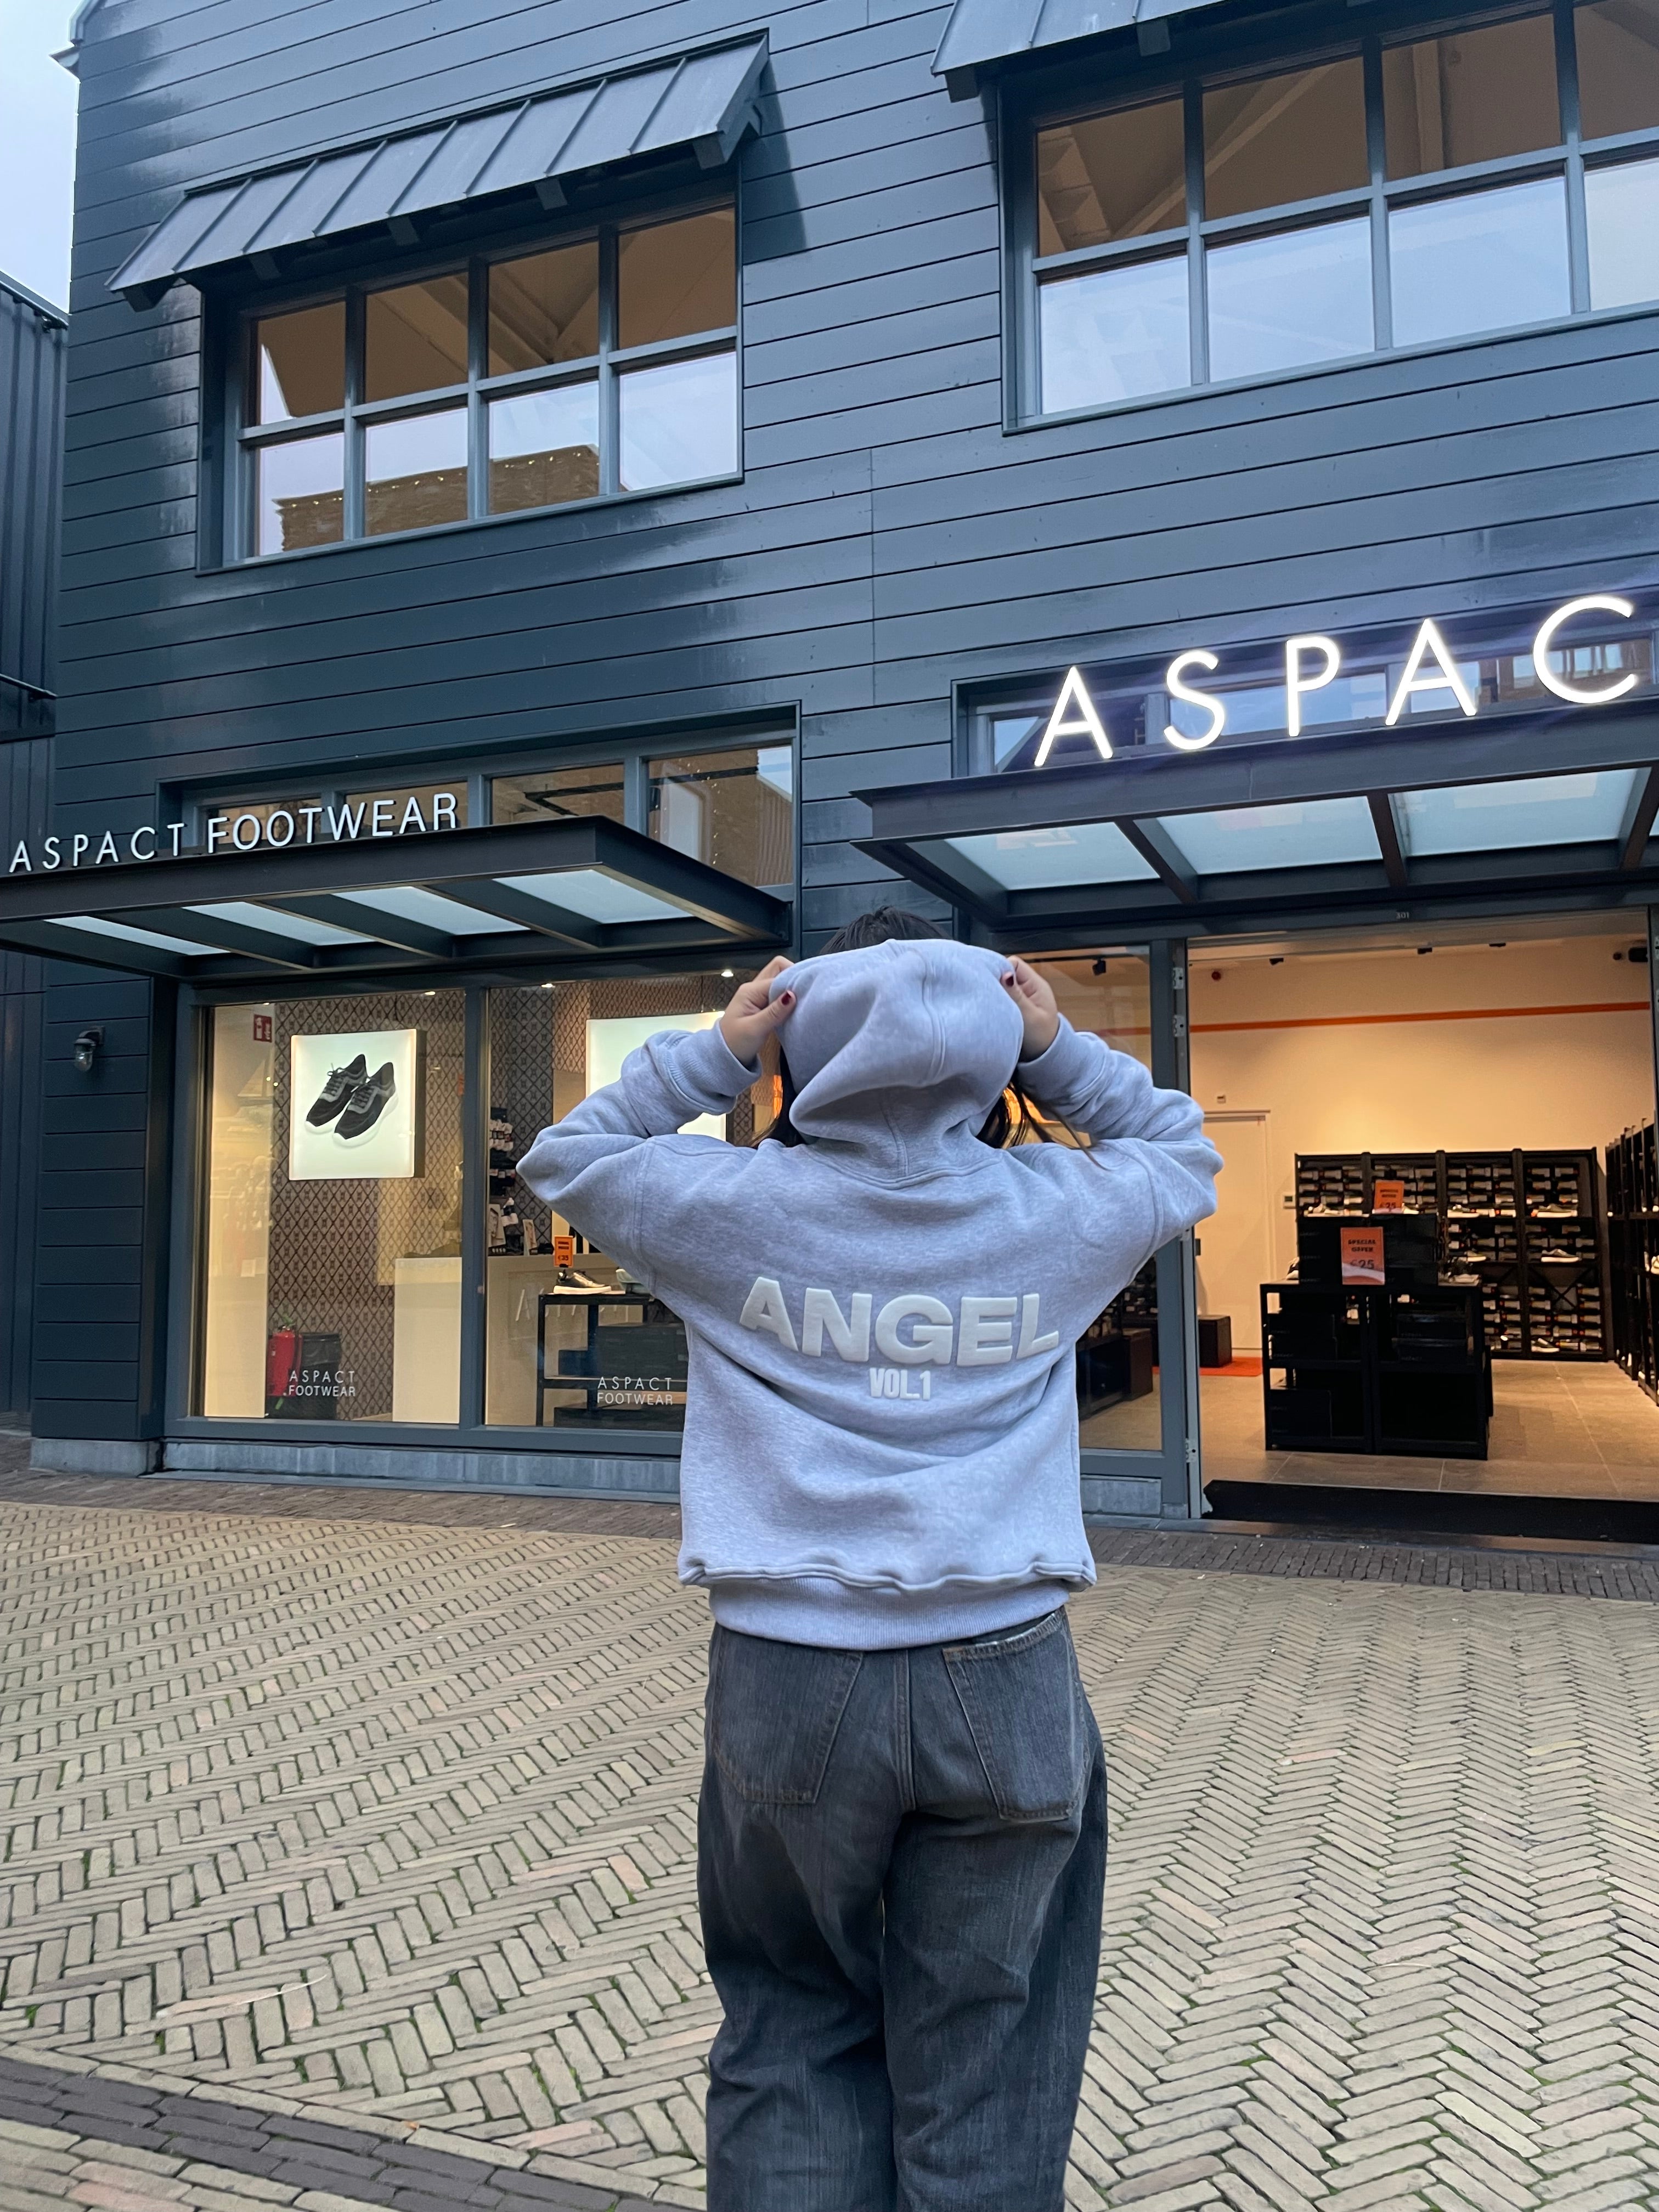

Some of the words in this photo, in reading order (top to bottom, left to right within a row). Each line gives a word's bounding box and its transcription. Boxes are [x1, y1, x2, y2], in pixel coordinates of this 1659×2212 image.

[8, 823, 185, 873] ASPACT
[207, 793, 458, 854] FOOTWEAR
[740, 1276, 1059, 1366] ANGEL
[289, 1370, 355, 1384] ASPACT
[597, 1376, 672, 1391] ASPACT
[289, 1385, 356, 1397] FOOTWEAR
[597, 1392, 673, 1406] FOOTWEAR
